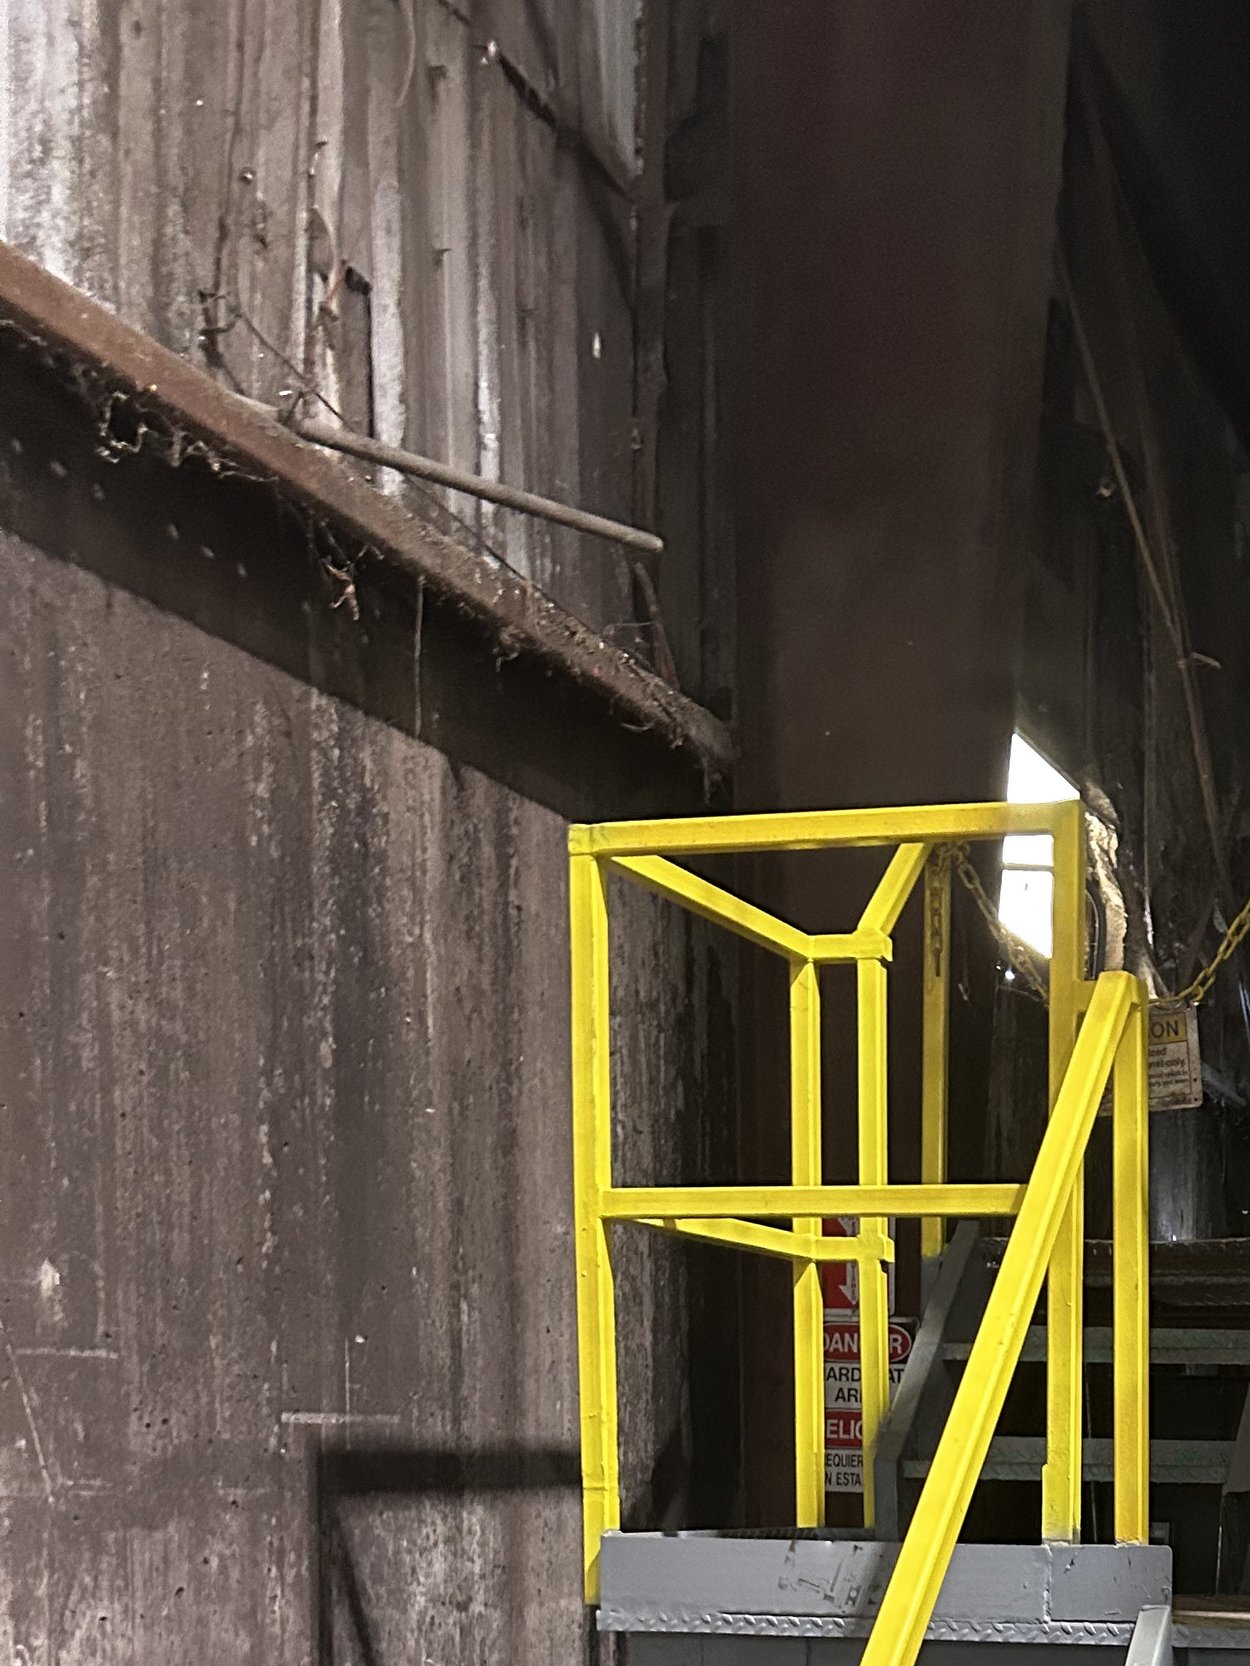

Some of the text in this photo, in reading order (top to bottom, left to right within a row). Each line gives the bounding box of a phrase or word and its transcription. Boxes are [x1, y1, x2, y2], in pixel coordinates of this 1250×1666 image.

[825, 1367, 862, 1382] ARD
[835, 1387, 862, 1403] AR
[836, 1472, 861, 1486] ESTA
